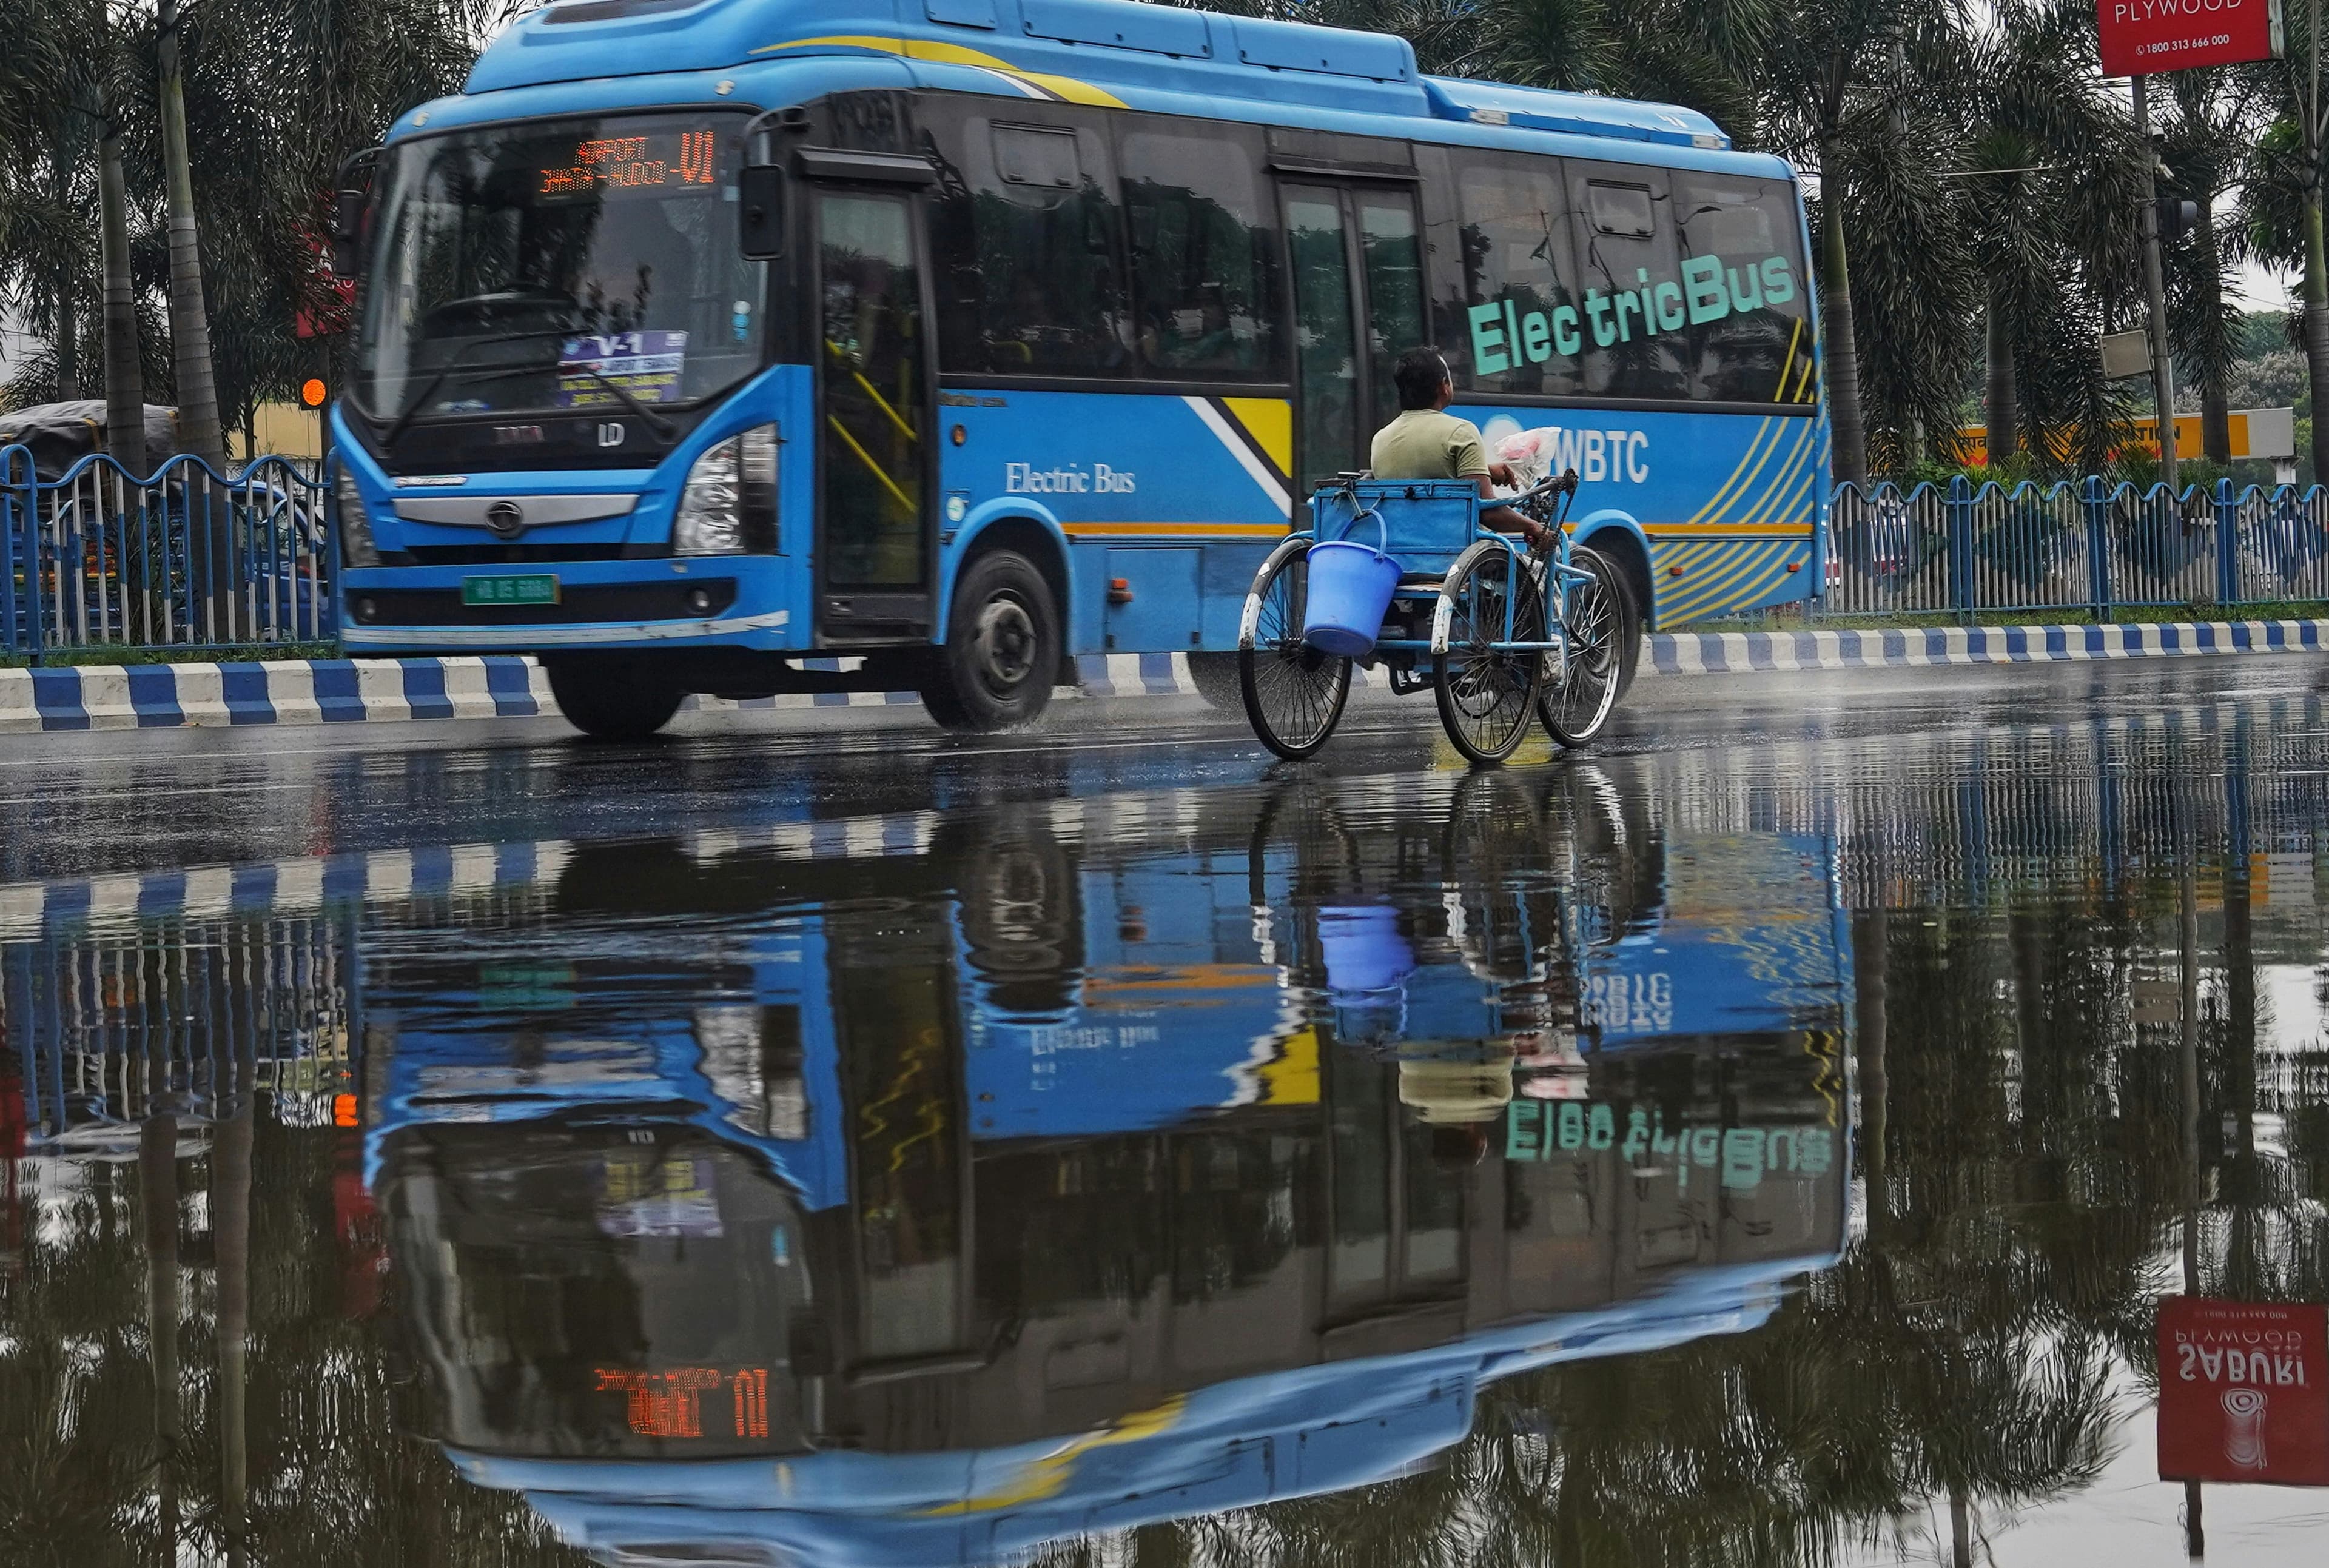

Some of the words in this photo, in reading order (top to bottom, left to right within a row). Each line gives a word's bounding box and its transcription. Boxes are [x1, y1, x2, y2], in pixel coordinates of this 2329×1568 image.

[2146, 41, 2169, 54] 1800
[2171, 39, 2190, 51] 313
[2192, 36, 2210, 48] 666
[2211, 34, 2230, 45] 000
[1554, 429, 1650, 483] WBTC
[1004, 463, 1090, 494] Electric
[1093, 463, 1136, 494] Bus
